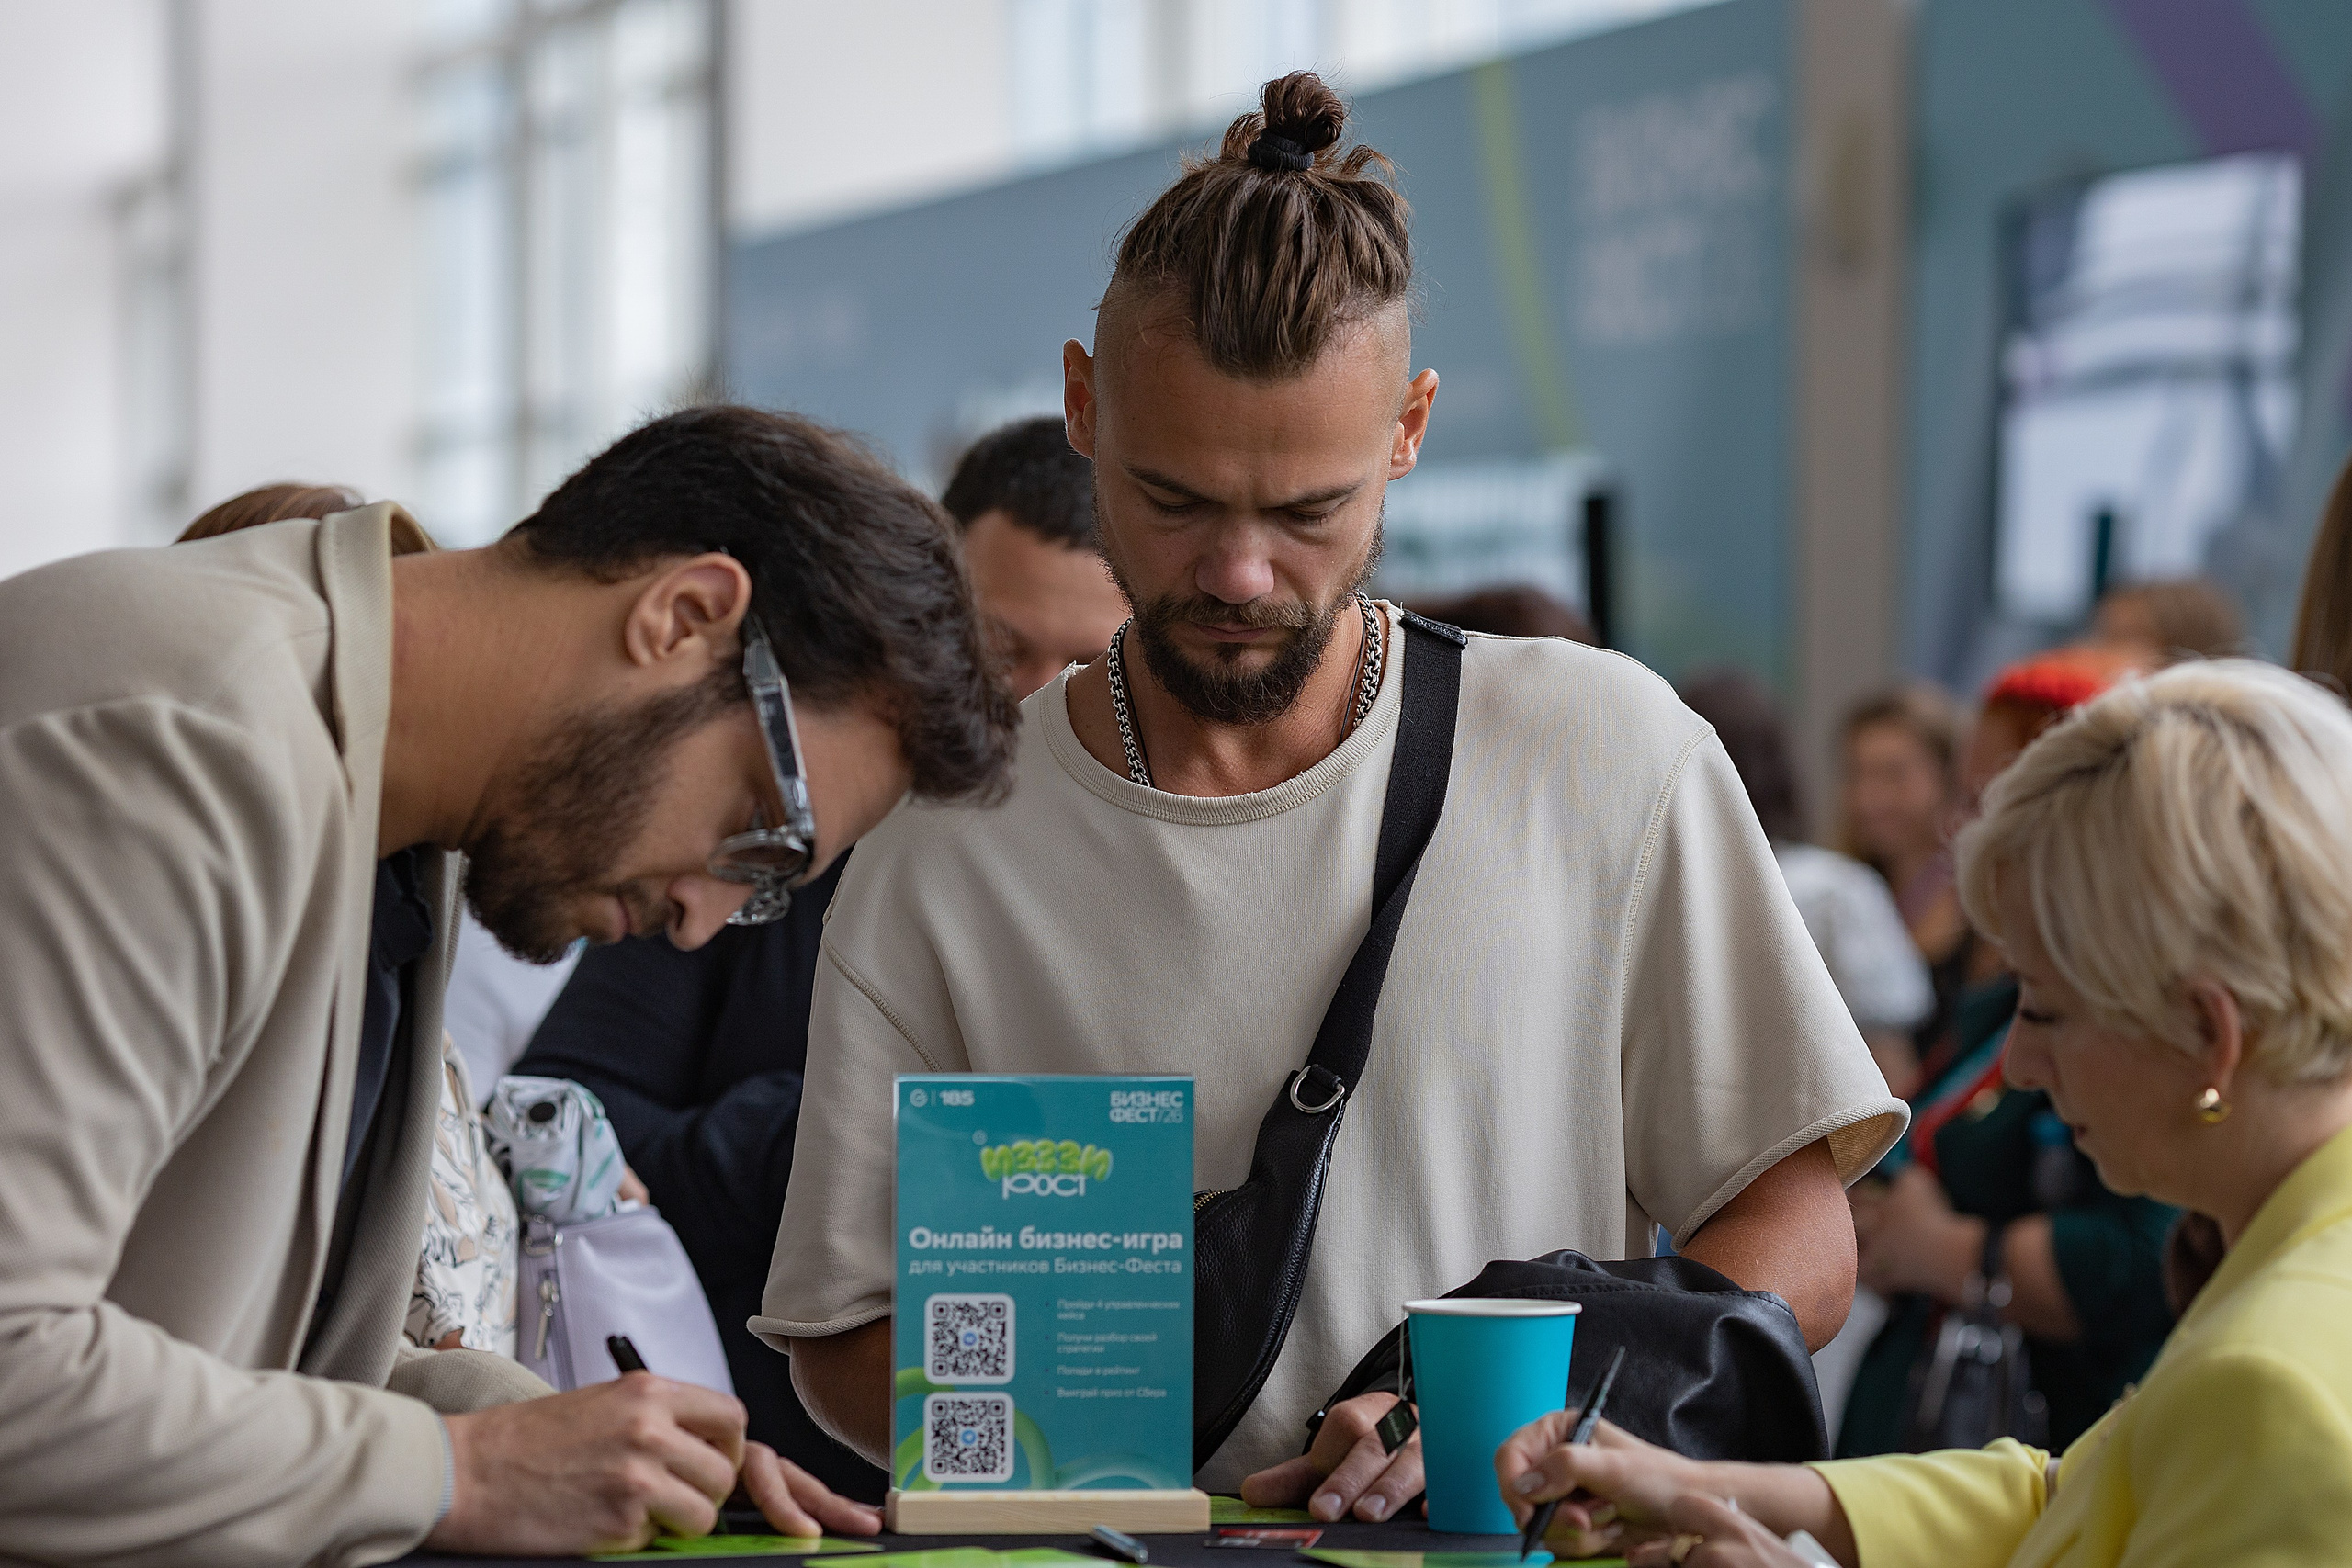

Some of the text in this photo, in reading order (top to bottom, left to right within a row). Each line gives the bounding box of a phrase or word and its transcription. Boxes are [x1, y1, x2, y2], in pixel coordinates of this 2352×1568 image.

[1110, 1090, 1184, 1108] БИЗНЕС
[909, 1225, 1182, 1255] Онлайн бизнес-игра
[909, 1257, 1182, 1277] для участников Бизнес-Феста
